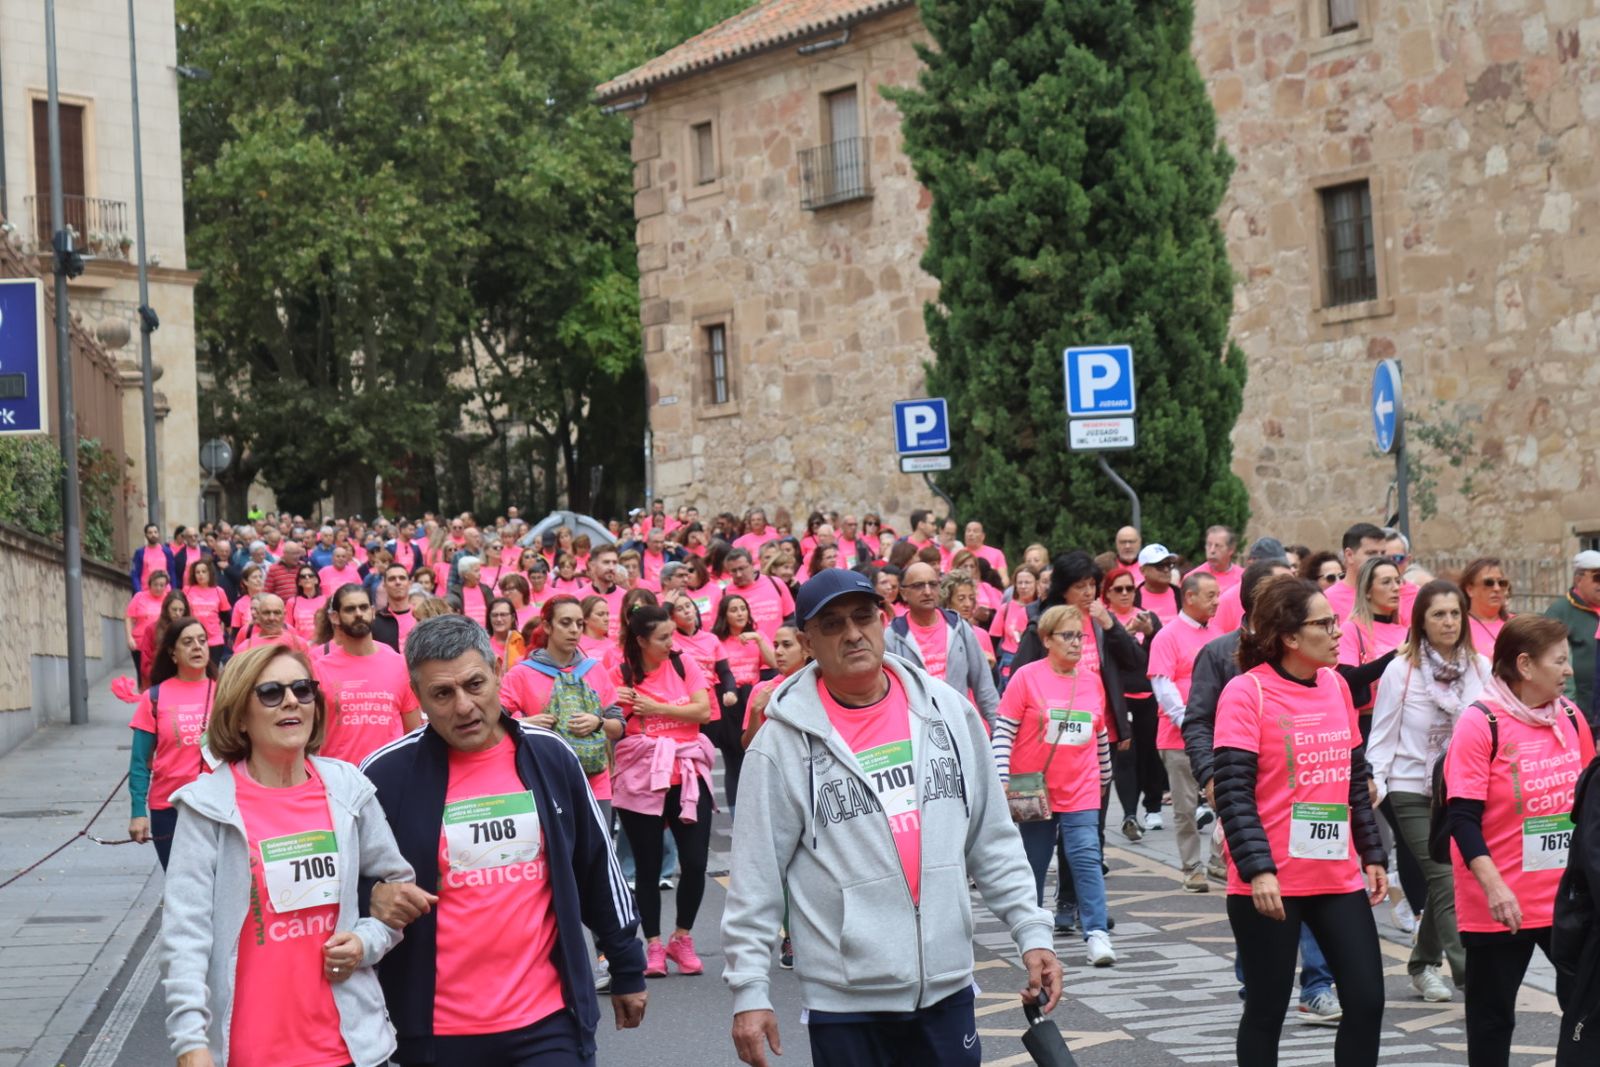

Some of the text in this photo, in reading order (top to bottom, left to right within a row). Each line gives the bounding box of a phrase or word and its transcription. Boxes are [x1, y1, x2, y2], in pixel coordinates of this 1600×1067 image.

[1078, 353, 1120, 408] P
[904, 405, 937, 447] P
[340, 690, 394, 700] En marcha
[341, 702, 379, 712] contra
[342, 712, 392, 725] cáncer
[1294, 731, 1315, 746] En
[1296, 746, 1348, 765] contra
[1521, 758, 1538, 772] En
[871, 764, 915, 793] 7107
[1523, 770, 1578, 792] contra
[469, 818, 517, 844] 7108
[1310, 823, 1339, 840] 7674
[1540, 832, 1571, 851] 7673
[289, 856, 336, 882] 7106
